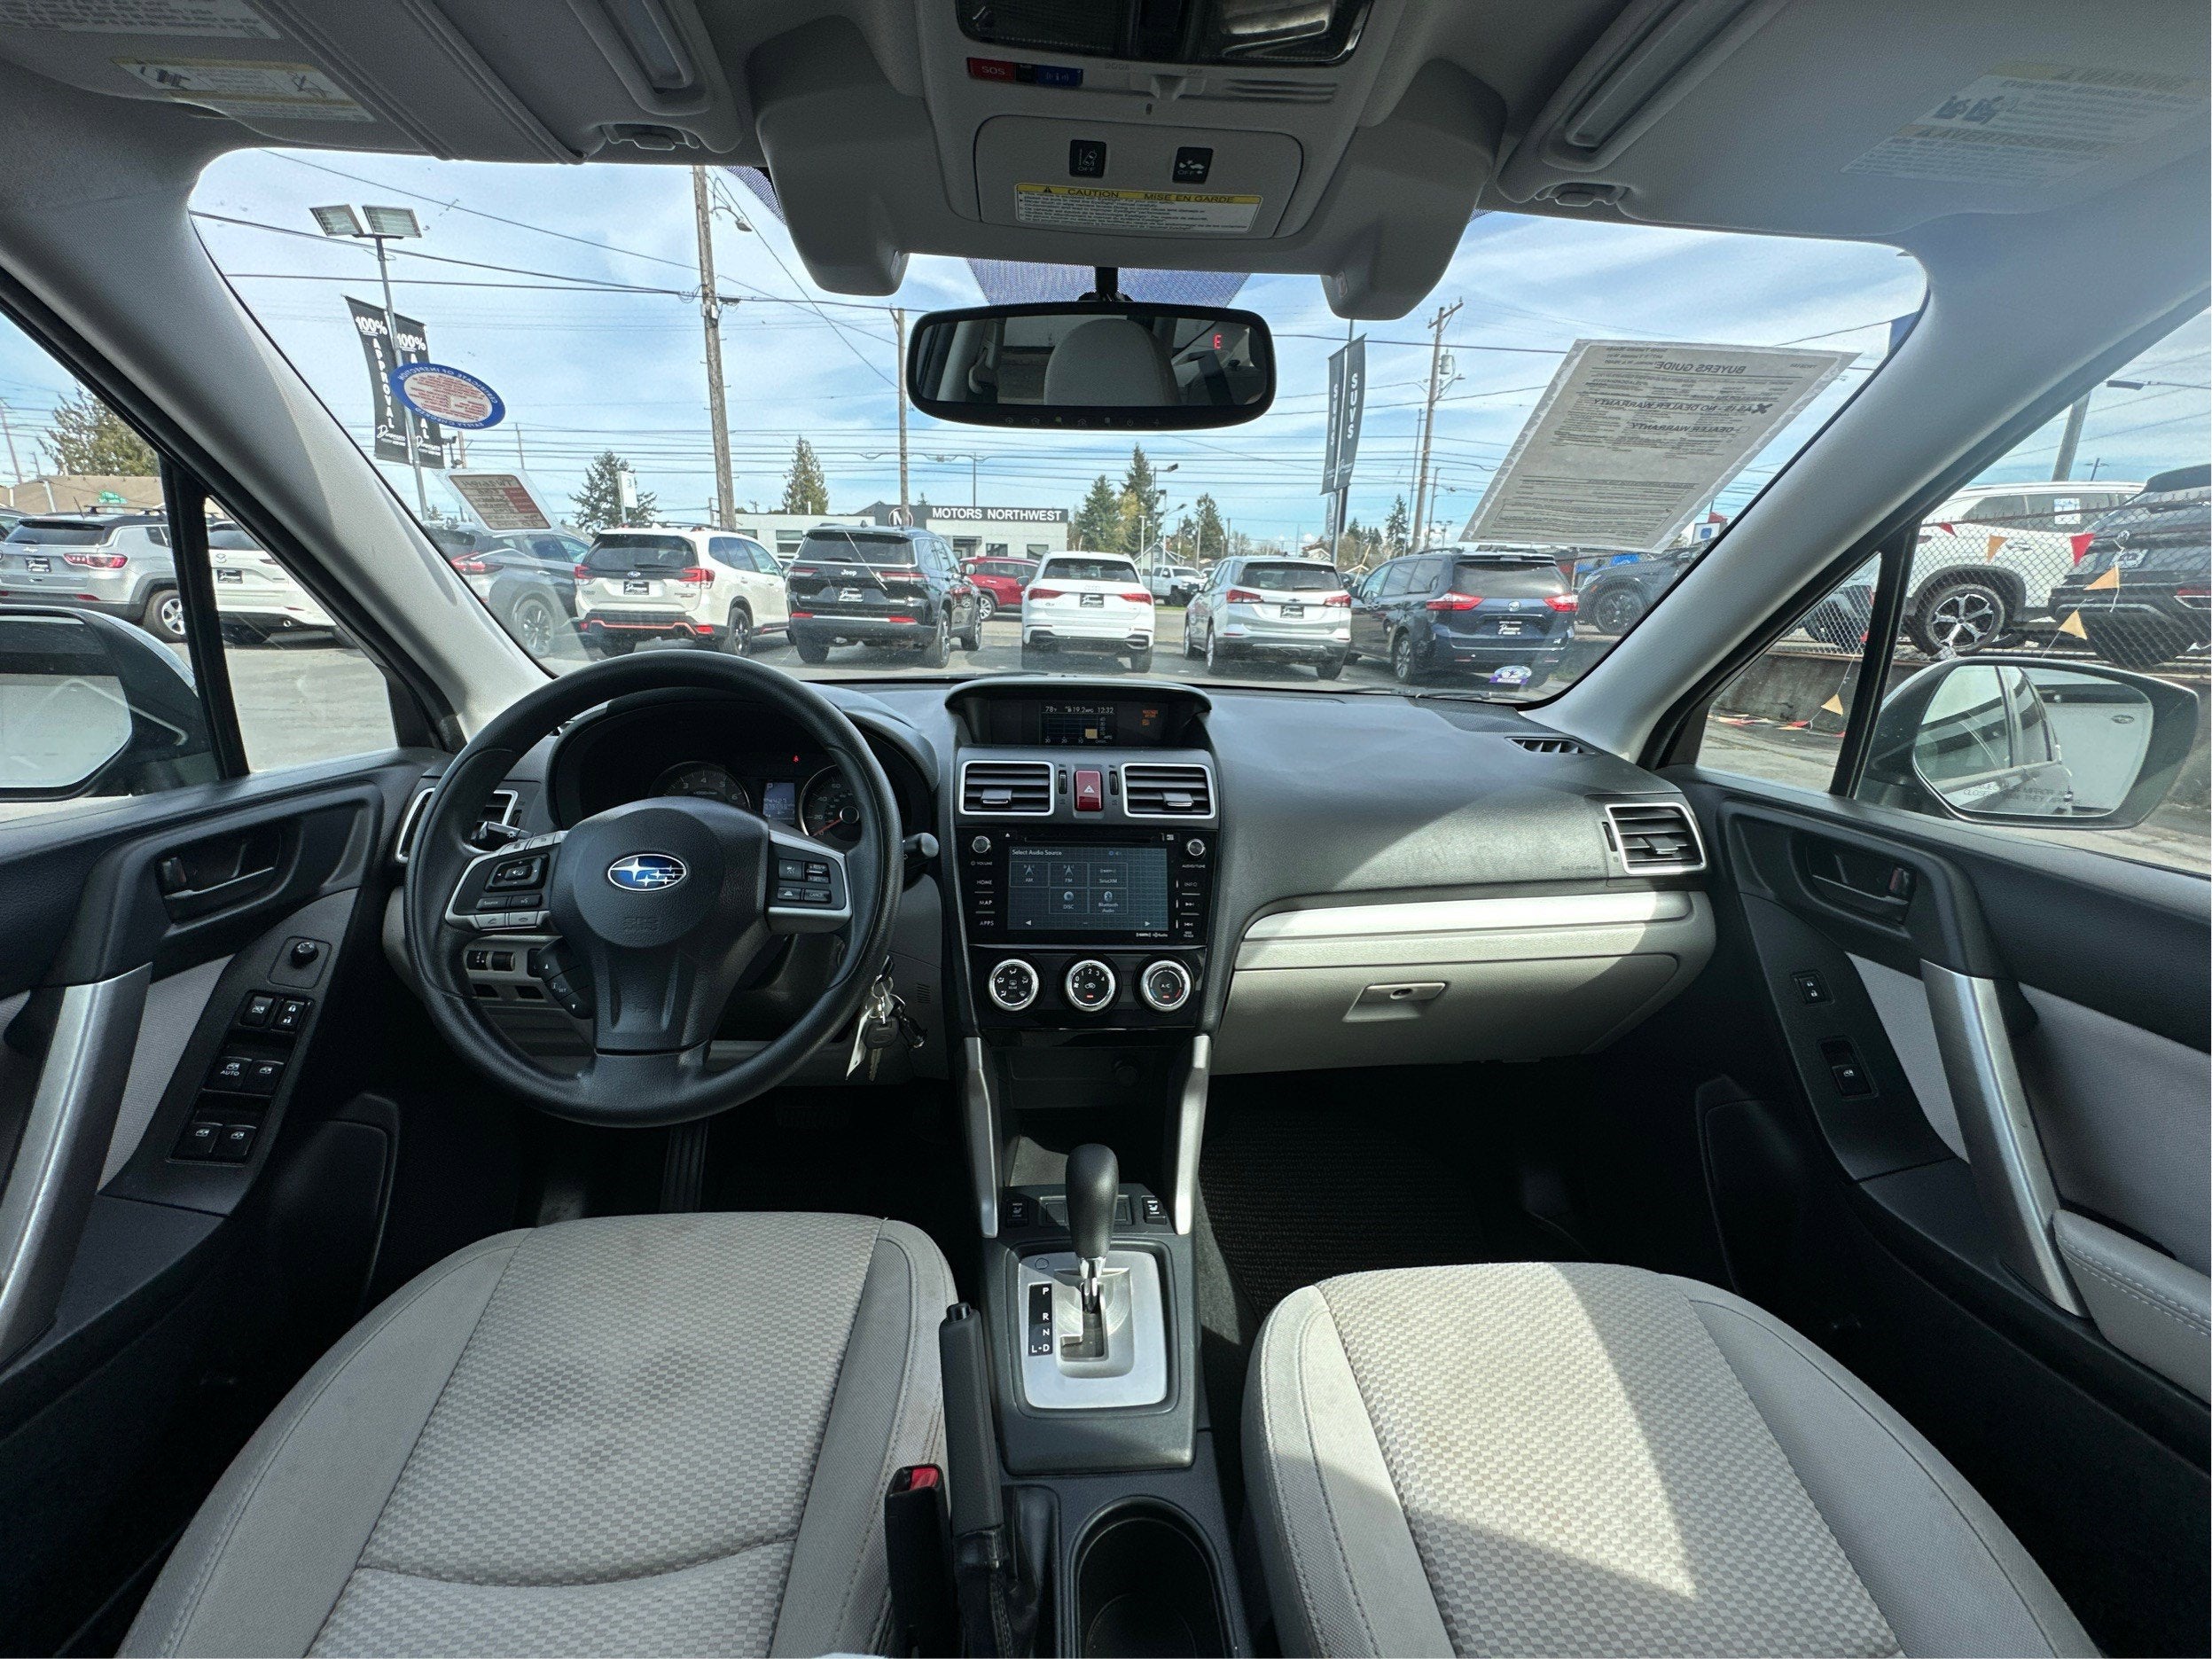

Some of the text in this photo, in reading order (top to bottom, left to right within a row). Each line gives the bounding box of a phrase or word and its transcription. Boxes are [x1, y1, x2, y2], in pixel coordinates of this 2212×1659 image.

[981, 66, 1005, 75] SOS
[1067, 188, 1119, 199] CAUTION
[1194, 195, 1235, 204] GARDE
[355, 316, 387, 336] 100%
[397, 333, 426, 351] 100%
[1214, 333, 1222, 349] E
[372, 338, 395, 429] APPROVAL
[1347, 372, 1358, 439] SUVS
[933, 507, 1062, 521] MOTORS NORTHWEST
[1042, 1287, 1050, 1295] P
[1042, 1312, 1050, 1321] R
